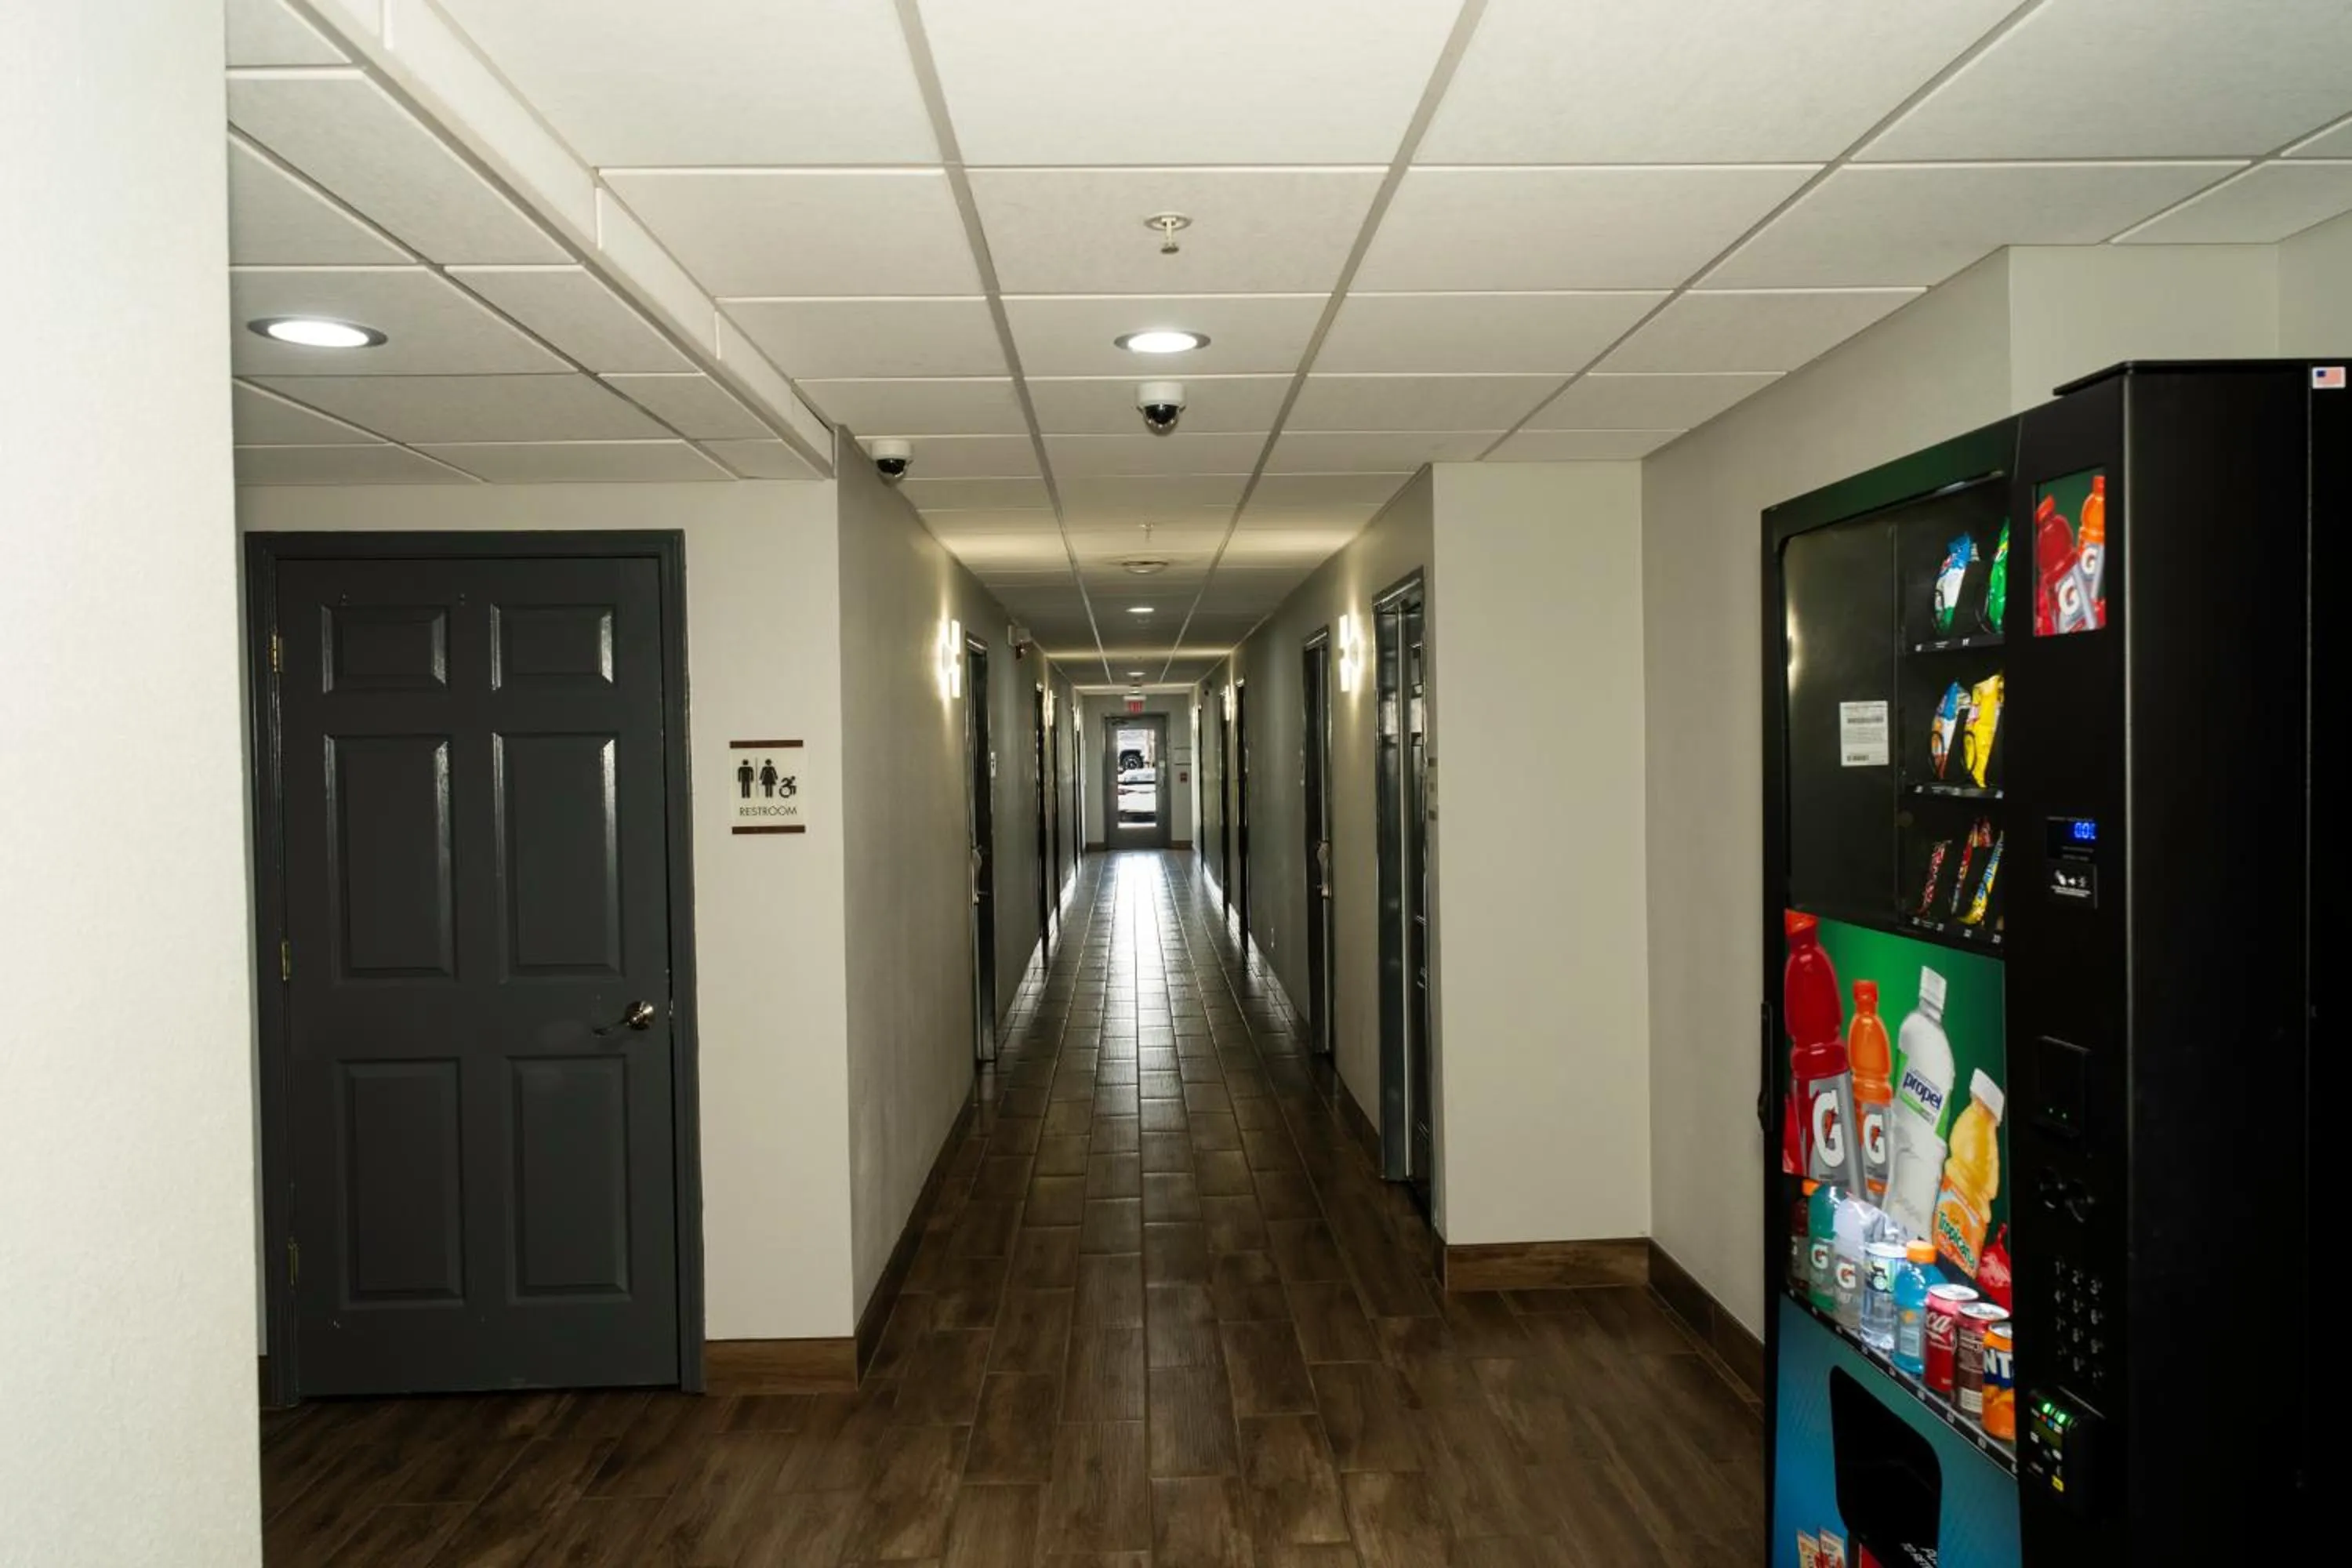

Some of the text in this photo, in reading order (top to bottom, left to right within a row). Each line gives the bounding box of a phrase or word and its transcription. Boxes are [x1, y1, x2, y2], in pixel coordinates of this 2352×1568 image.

[739, 805, 797, 816] RESTROOM
[1903, 1071, 1943, 1111] propel
[1813, 1089, 1845, 1167] G
[1863, 1113, 1886, 1164] G
[1811, 1243, 1829, 1269] G
[1836, 1263, 1857, 1289] G
